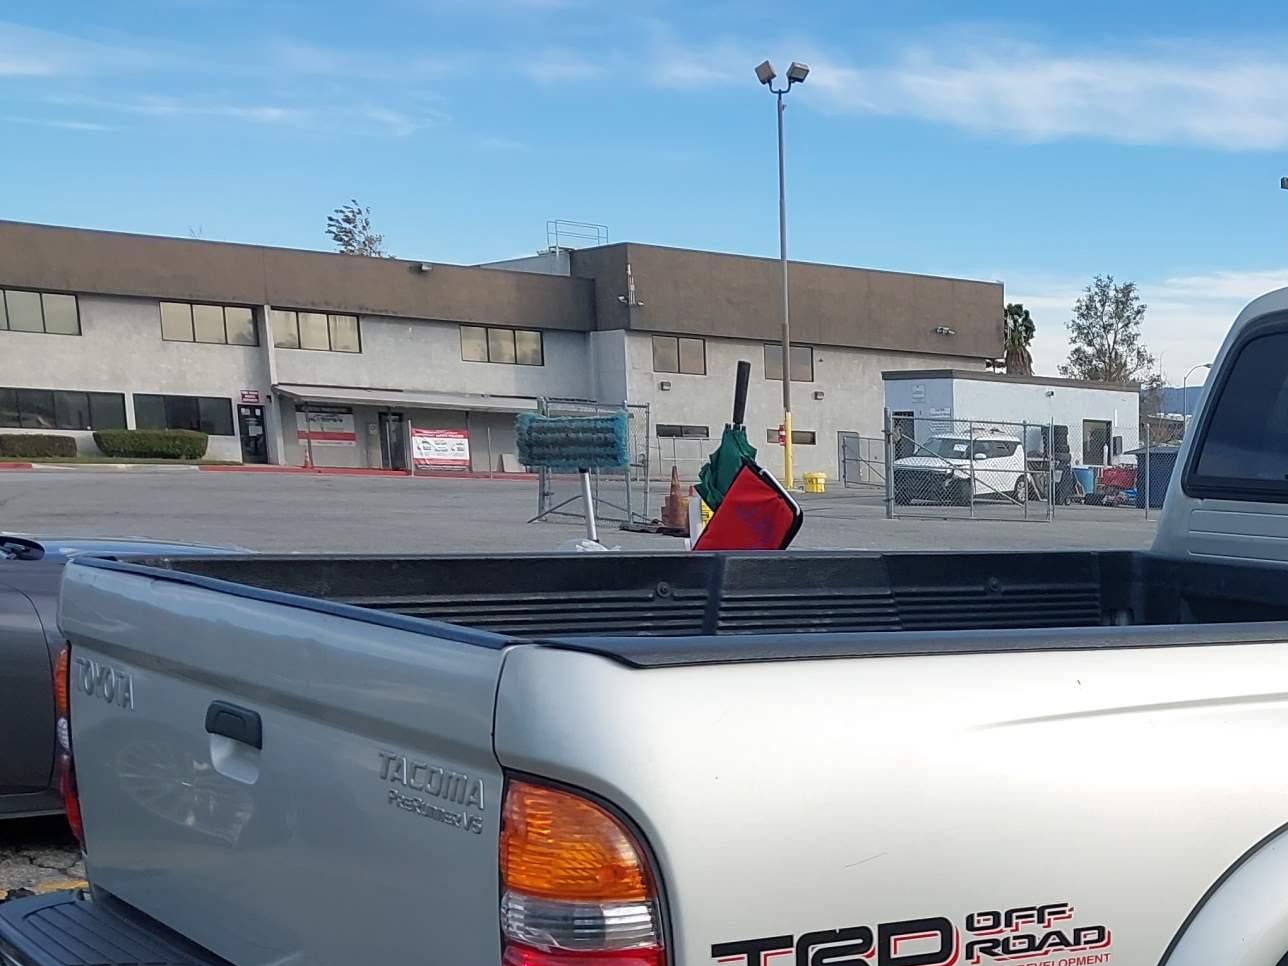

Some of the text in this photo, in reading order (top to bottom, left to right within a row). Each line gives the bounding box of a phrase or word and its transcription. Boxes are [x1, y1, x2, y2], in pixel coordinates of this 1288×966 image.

[76, 656, 135, 712] TOYOTA
[379, 751, 485, 811] TACOMA
[965, 902, 1075, 935] OFF
[964, 924, 1112, 965] ROAD
